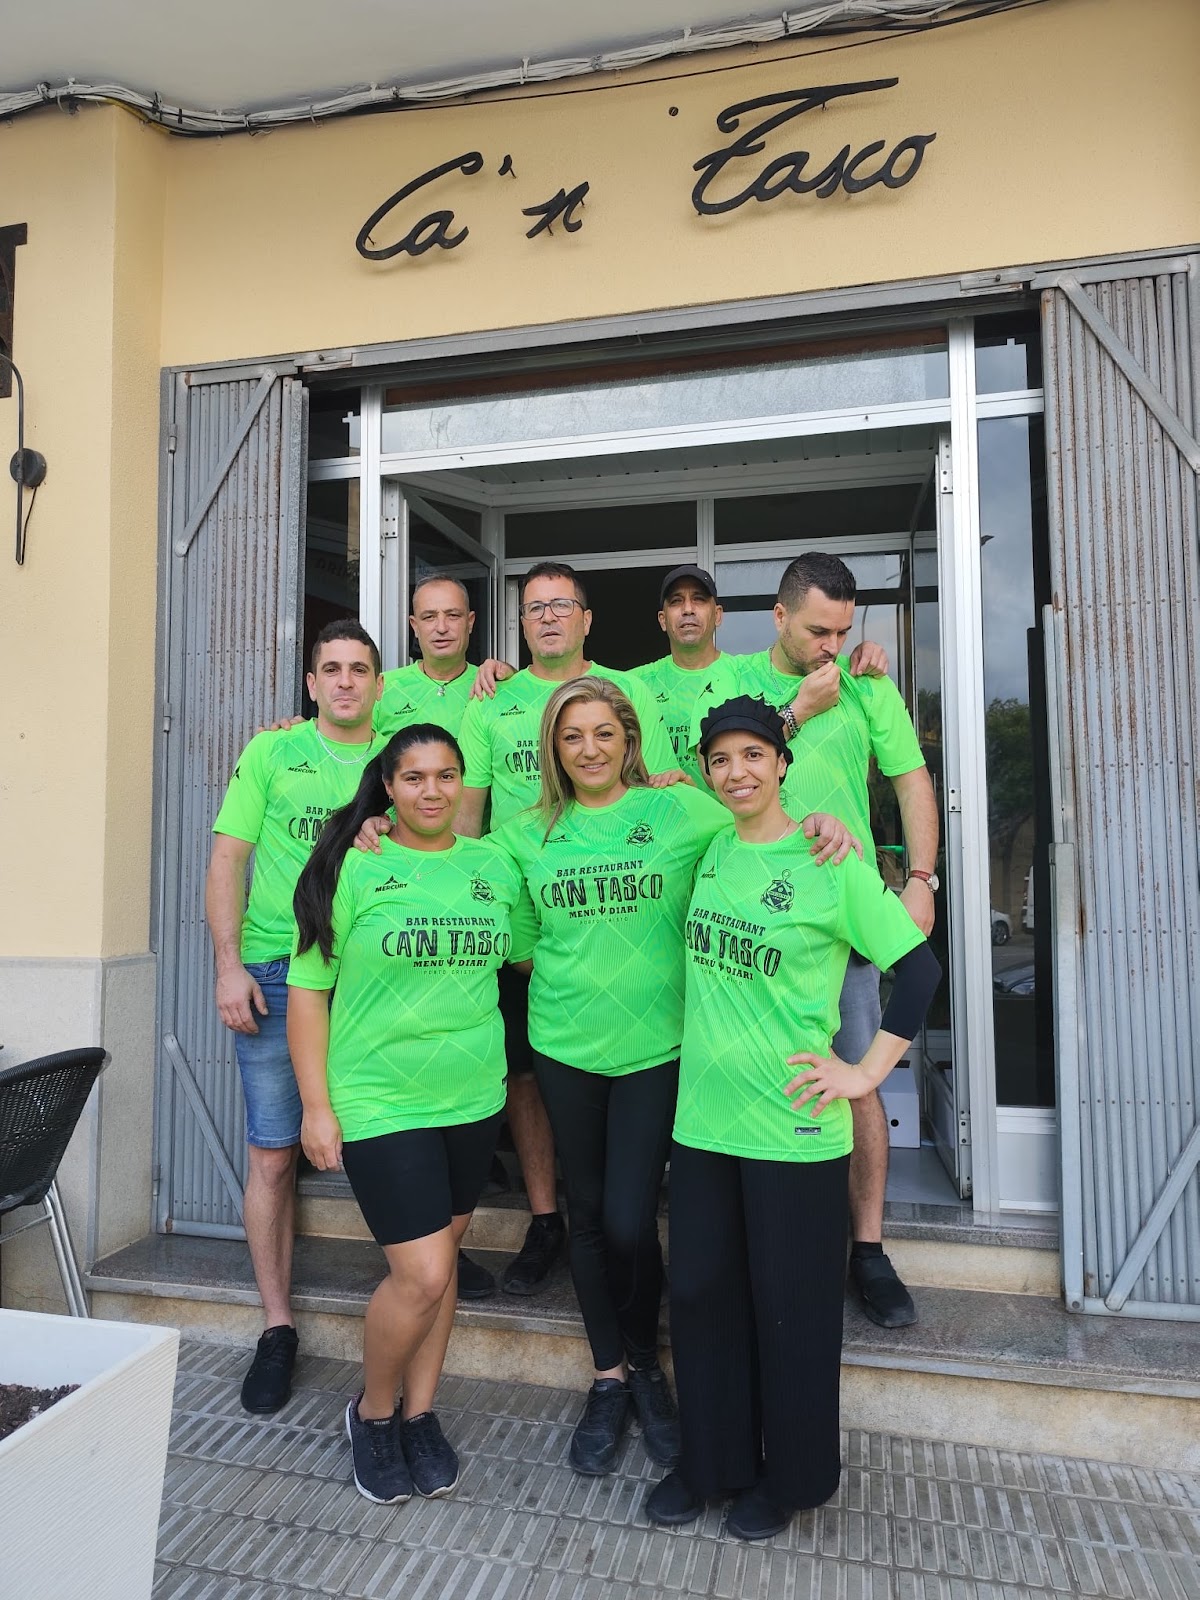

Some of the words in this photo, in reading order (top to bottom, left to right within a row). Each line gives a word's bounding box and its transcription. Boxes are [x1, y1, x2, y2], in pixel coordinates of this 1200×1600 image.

[693, 77, 937, 215] Tasco
[517, 740, 533, 748] BAR
[306, 806, 322, 815] BAR
[557, 868, 576, 878] BAR
[579, 860, 644, 875] RESTAURANT
[375, 883, 408, 892] MERCURY
[540, 878, 587, 908] CA'N
[594, 873, 663, 903] TASCO
[609, 905, 638, 915] DIARI
[406, 917, 428, 926] BAR
[432, 917, 496, 927] RESTAURANT
[693, 908, 709, 919] BAR
[710, 912, 766, 937] RESTAURANT
[381, 928, 438, 957] CA'N
[718, 929, 782, 978] TASCO
[413, 958, 444, 968] MENÚ
[726, 966, 754, 981] DIARI
